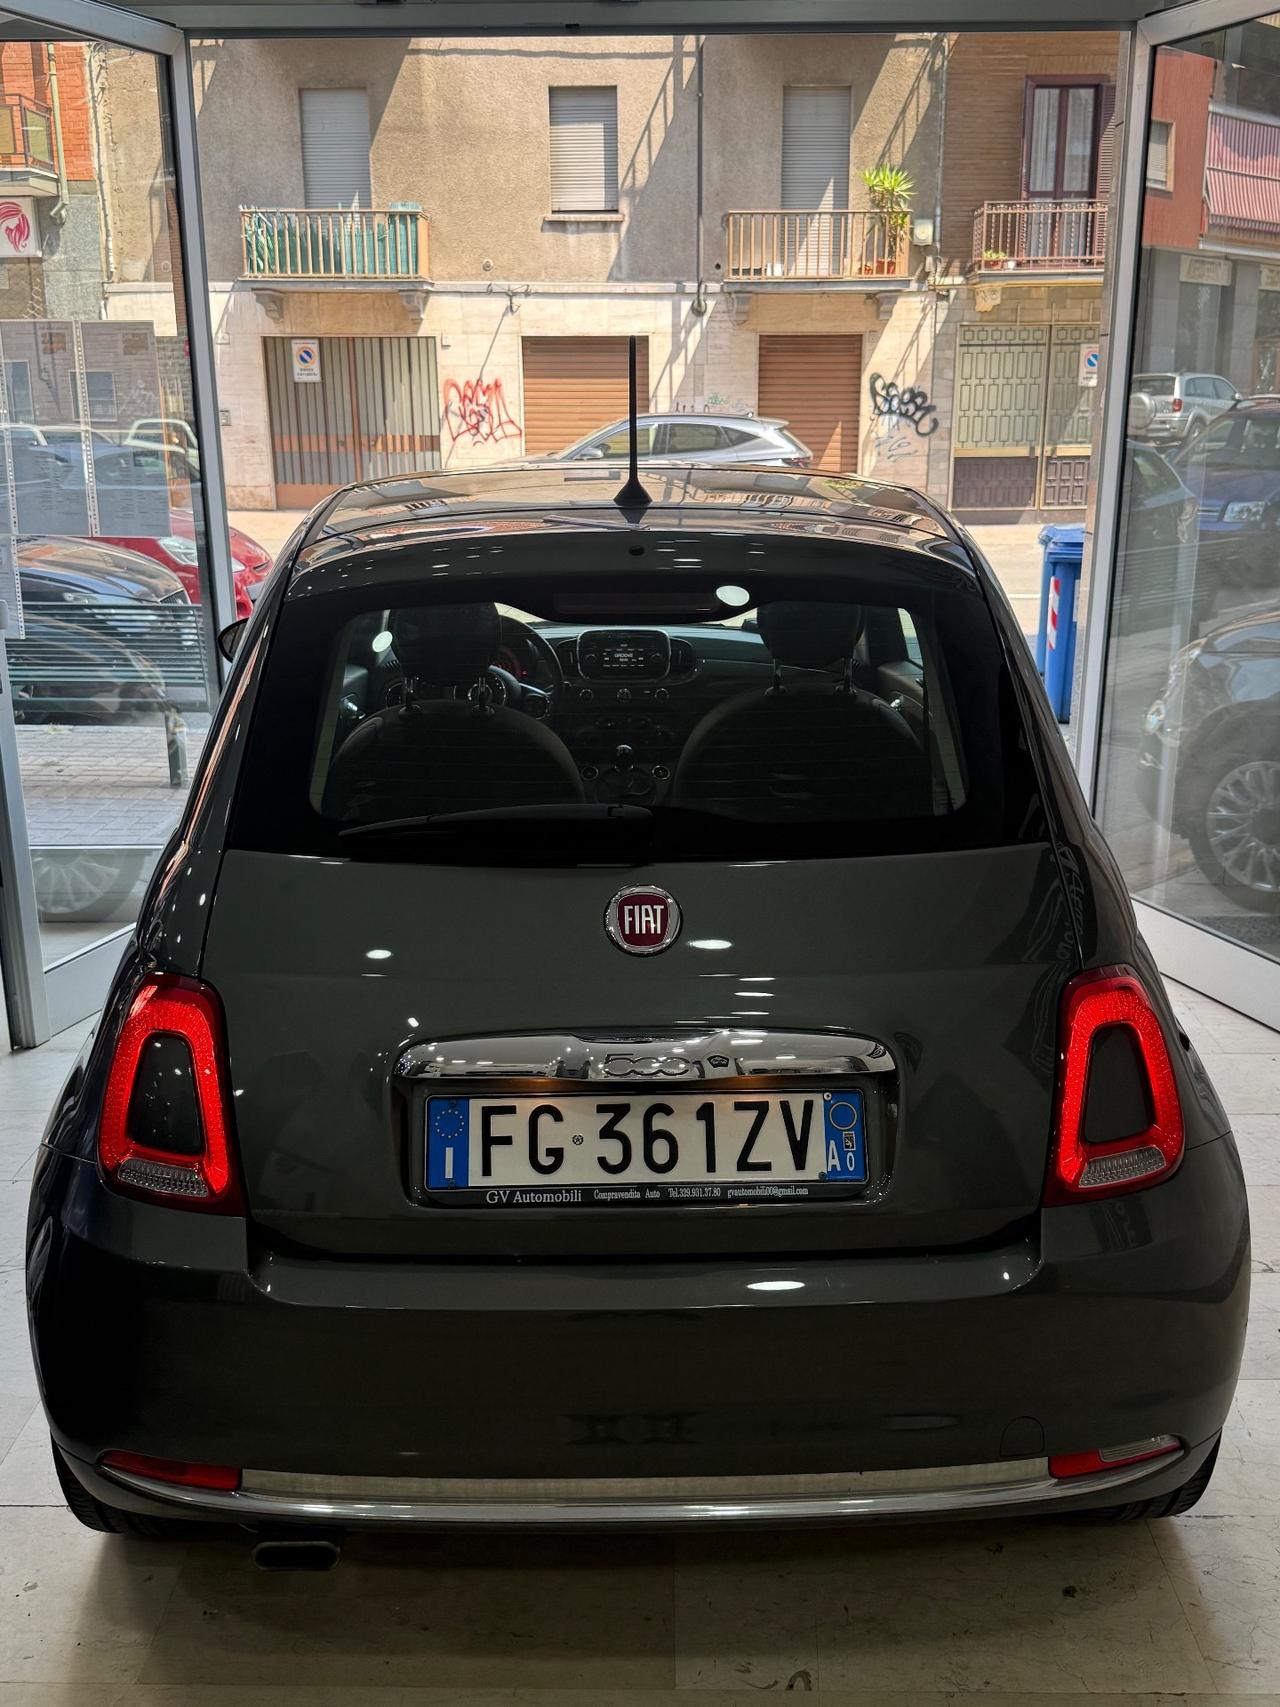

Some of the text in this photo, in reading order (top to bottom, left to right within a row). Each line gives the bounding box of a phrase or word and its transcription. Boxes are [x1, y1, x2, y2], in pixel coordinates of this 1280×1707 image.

[624, 905, 664, 935] FIAT
[602, 1053, 690, 1077] 500
[444, 1147, 454, 1179] I
[481, 1104, 564, 1176] FG
[595, 1098, 814, 1174] 361ZV
[486, 1190, 511, 1203] GV
[513, 1188, 582, 1203] Automobili
[593, 1187, 641, 1201] Compravendita
[645, 1188, 660, 1198] Auto
